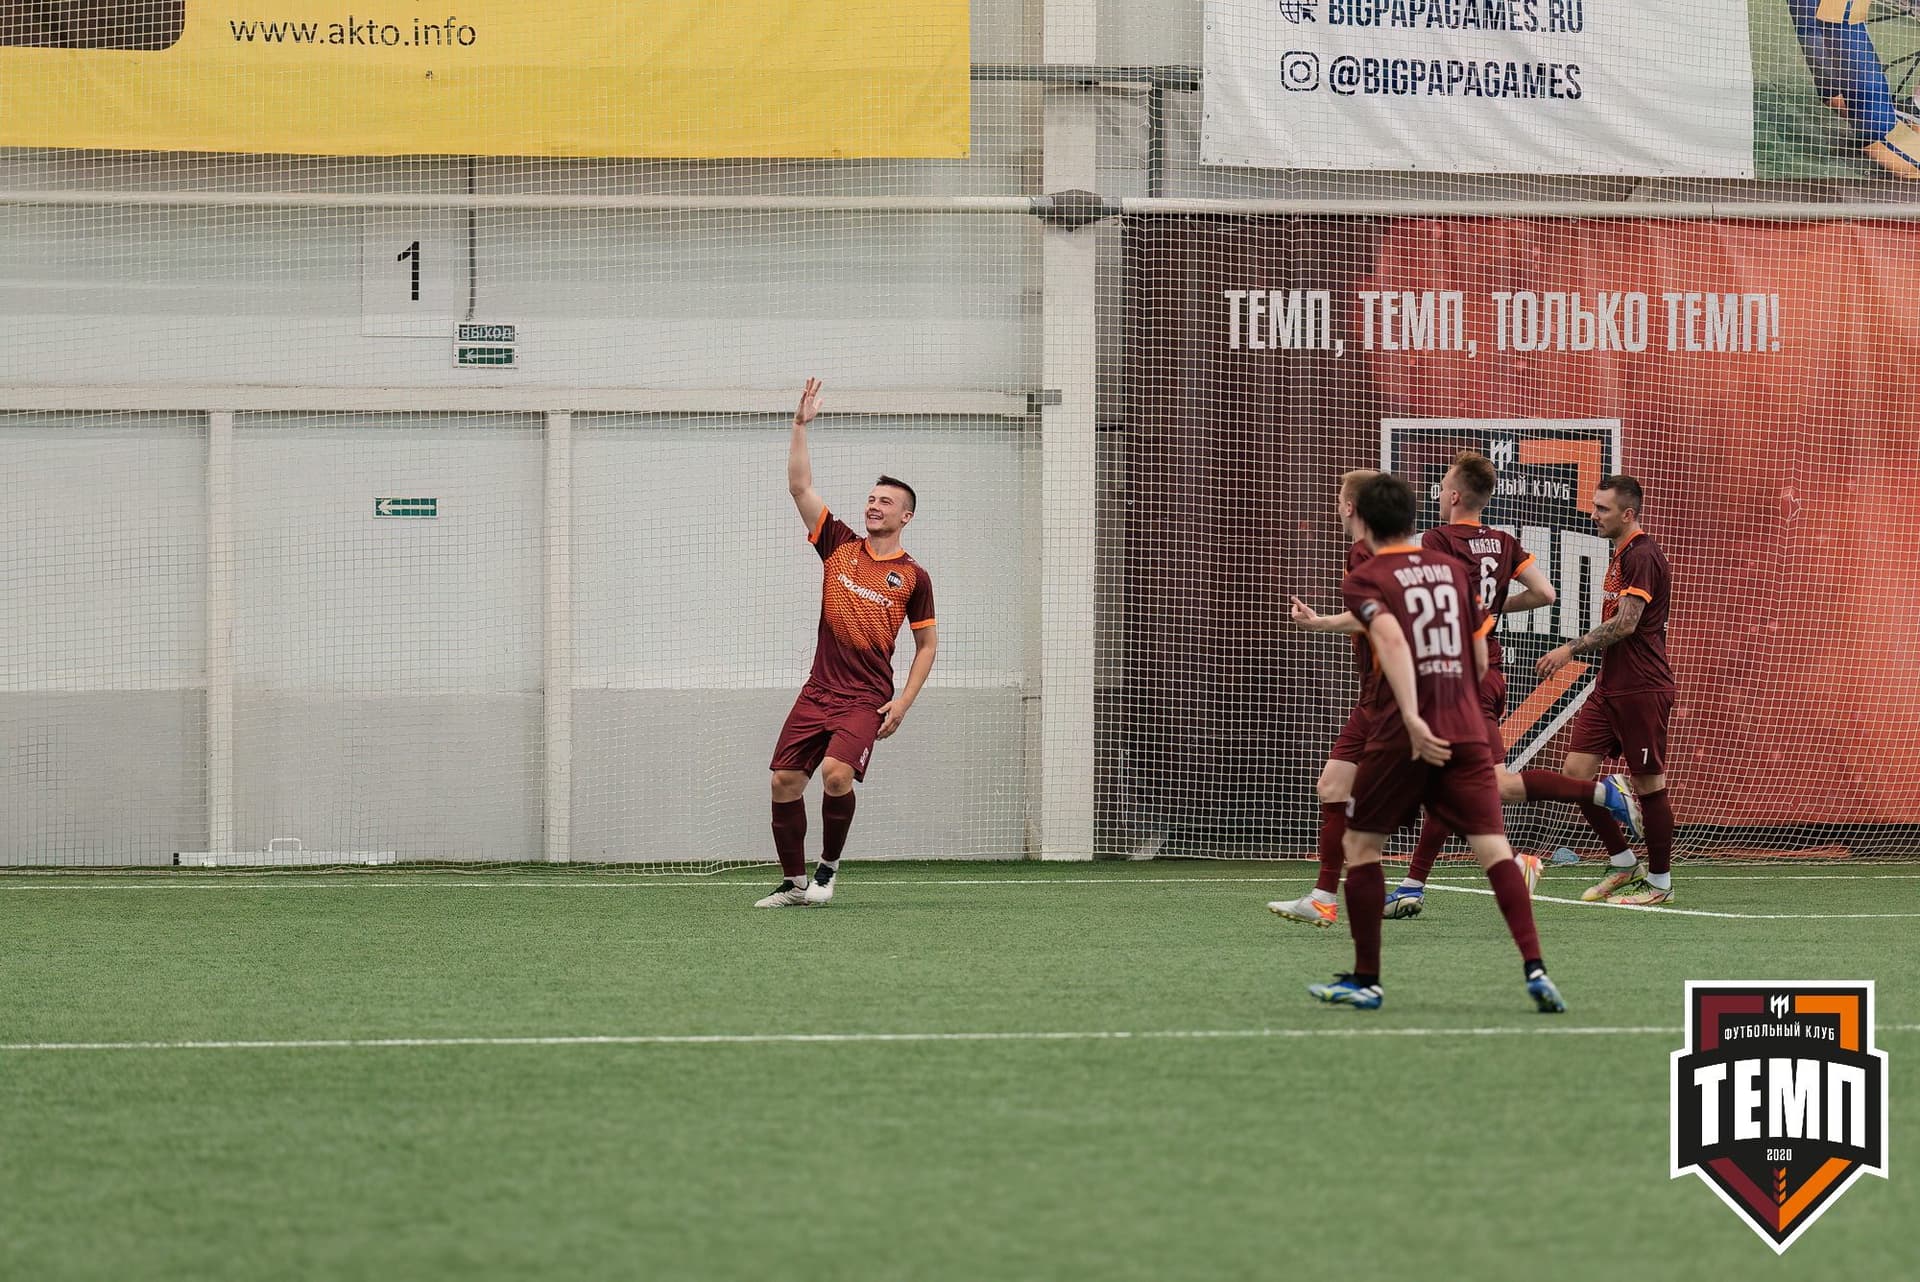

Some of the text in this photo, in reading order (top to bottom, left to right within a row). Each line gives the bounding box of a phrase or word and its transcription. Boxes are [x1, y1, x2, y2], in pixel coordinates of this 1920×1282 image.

[229, 15, 477, 47] www.akto.info
[1328, 0, 1584, 33] BIGPAPAGAMES.RU
[1328, 54, 1583, 100] @BIGPAPAGAMES
[397, 240, 420, 301] 1
[459, 325, 513, 341] ВЫХОД
[1223, 289, 1781, 359] ТЕМП, ТЕМП, ТОЛЬКО ТЕМП!
[1533, 480, 1570, 500] КЛУБ
[1480, 556, 1499, 610] 6
[1404, 584, 1462, 659] 23
[1641, 747, 1649, 766] 7
